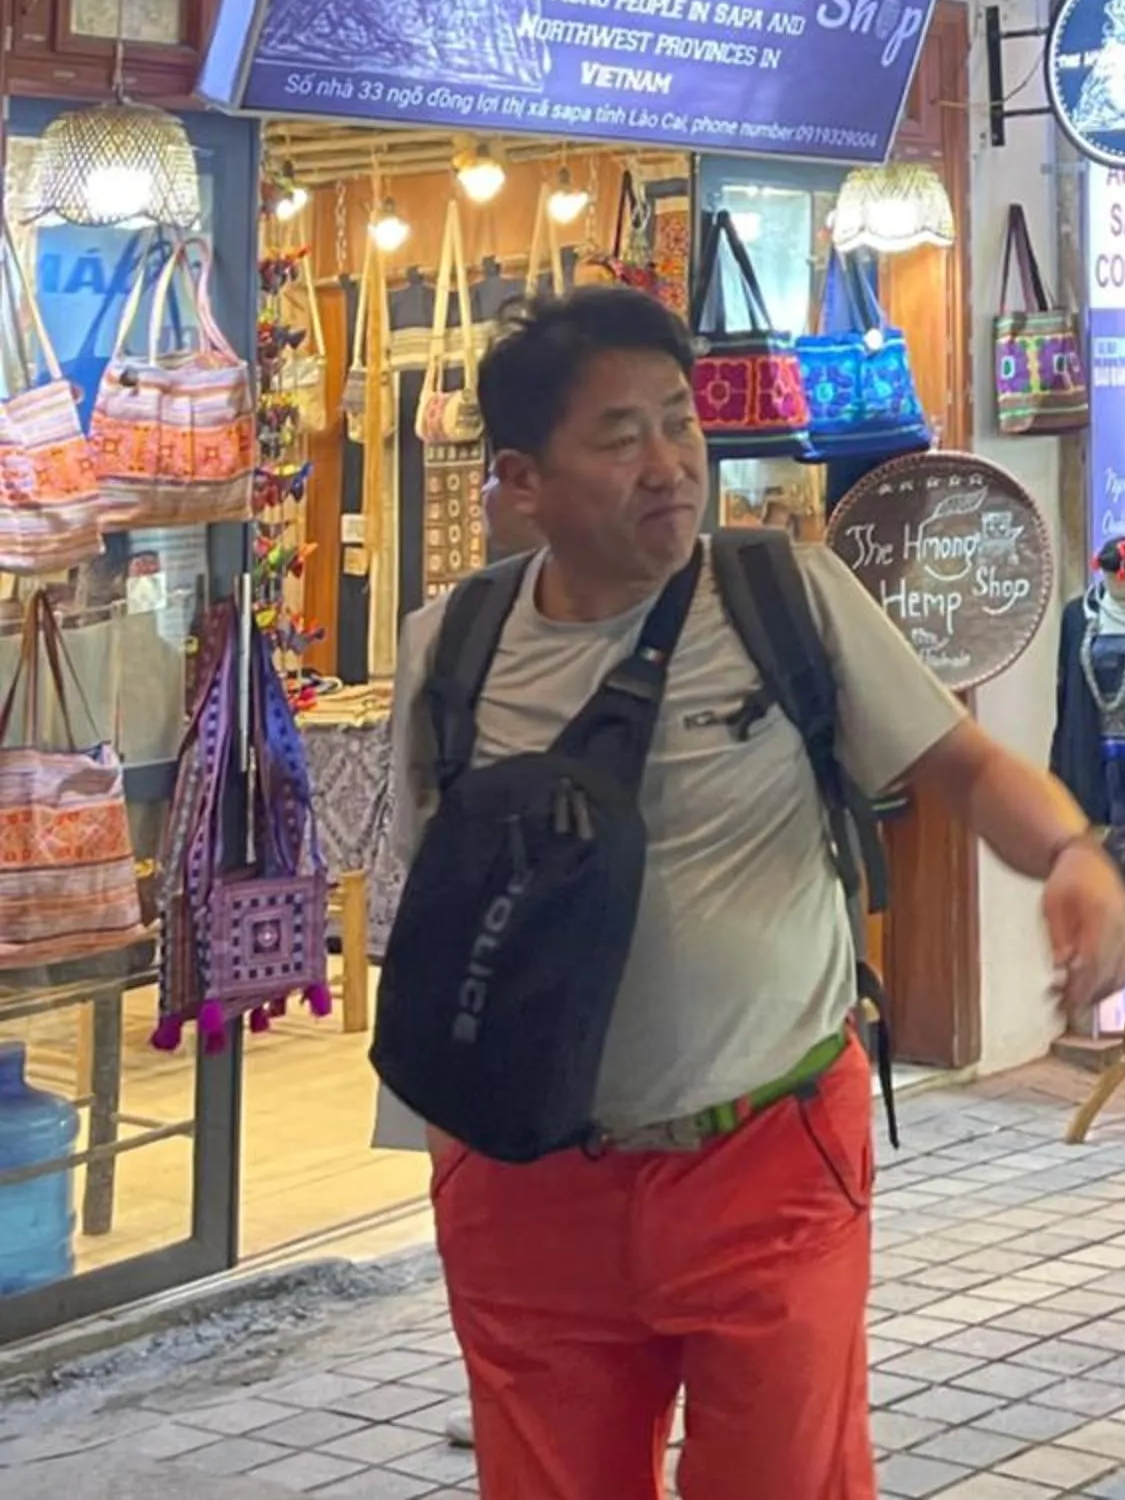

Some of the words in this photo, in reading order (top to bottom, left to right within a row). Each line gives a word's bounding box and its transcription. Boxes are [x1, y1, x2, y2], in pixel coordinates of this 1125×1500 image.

[687, 0, 712, 24] IN
[713, 1, 764, 31] SAPA
[766, 12, 806, 36] AND
[654, 32, 758, 67] PROVINCES
[759, 47, 782, 69] IN
[580, 59, 674, 95] VIETNAM
[358, 80, 384, 101] 33
[551, 103, 593, 127] sapa
[690, 113, 738, 136] phone
[844, 523, 895, 570] The
[902, 523, 981, 581] Hmong
[880, 578, 963, 635] Hemp
[972, 566, 1031, 615] Shop
